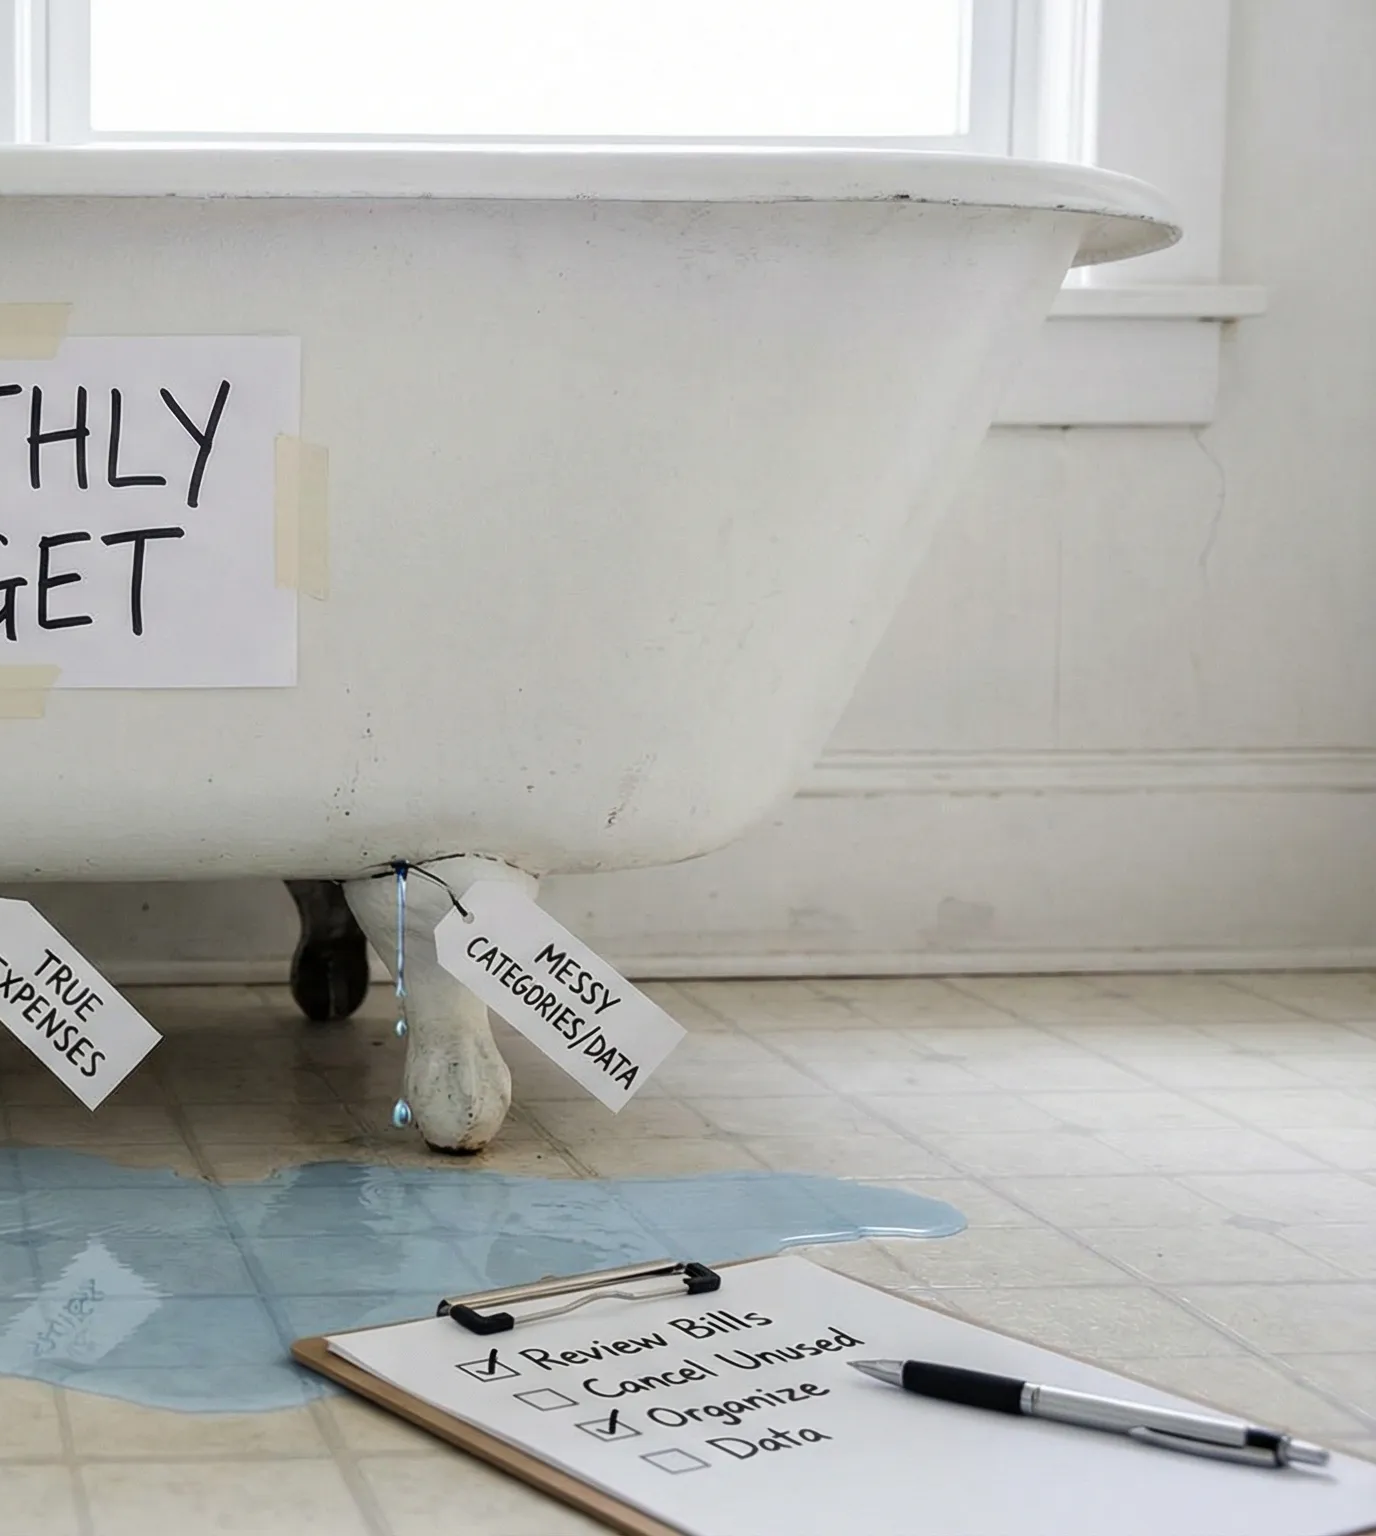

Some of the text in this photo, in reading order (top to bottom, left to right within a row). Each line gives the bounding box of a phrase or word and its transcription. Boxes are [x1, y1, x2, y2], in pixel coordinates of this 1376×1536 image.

[33, 947, 105, 1024] TRUE
[465, 935, 641, 1092] CATEGORIES/DATA
[532, 942, 623, 1016] MESSY
[517, 1309, 774, 1372] Review Bills
[581, 1325, 867, 1400] Cancel Unused
[645, 1379, 832, 1427] Organize
[704, 1425, 833, 1461] Data
